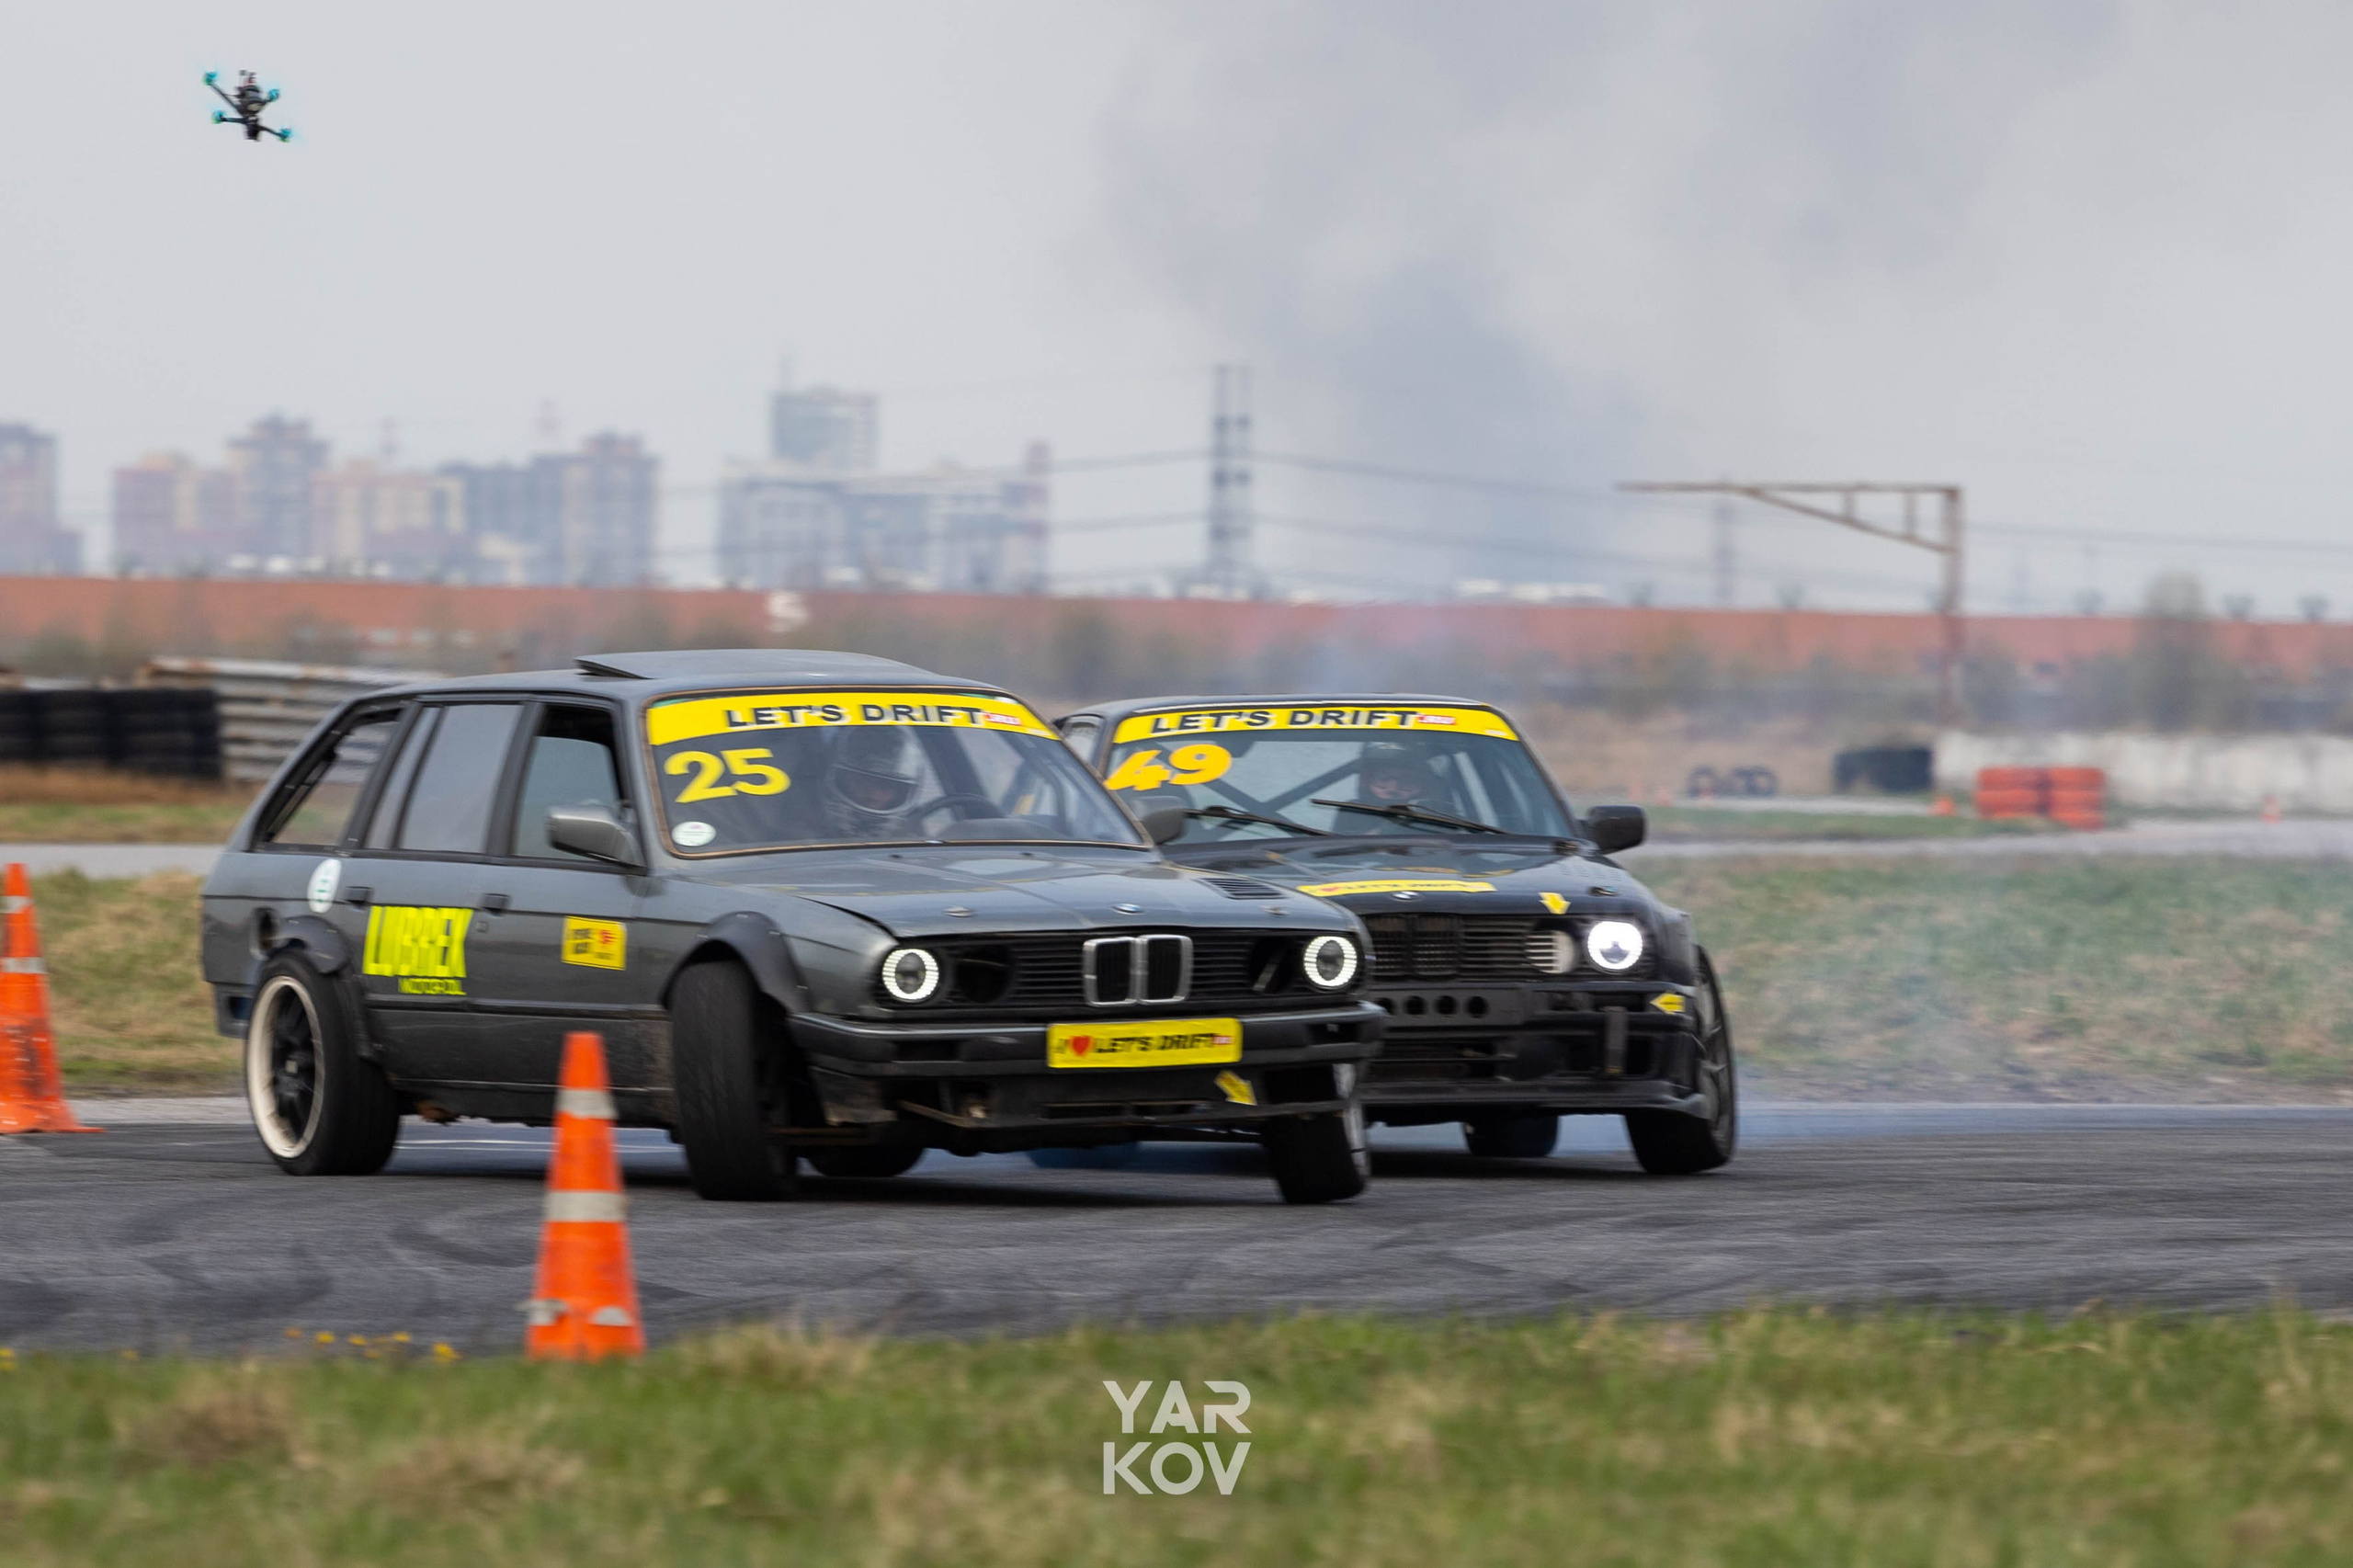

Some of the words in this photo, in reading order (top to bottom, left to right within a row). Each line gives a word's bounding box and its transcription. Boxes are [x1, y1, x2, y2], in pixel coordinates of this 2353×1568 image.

[725, 705, 845, 727] LET'S
[862, 704, 984, 724] DRIFT
[1150, 710, 1270, 733] LET'S
[1289, 710, 1421, 727] DRIFT
[664, 747, 791, 803] 25
[1104, 744, 1232, 790] 49
